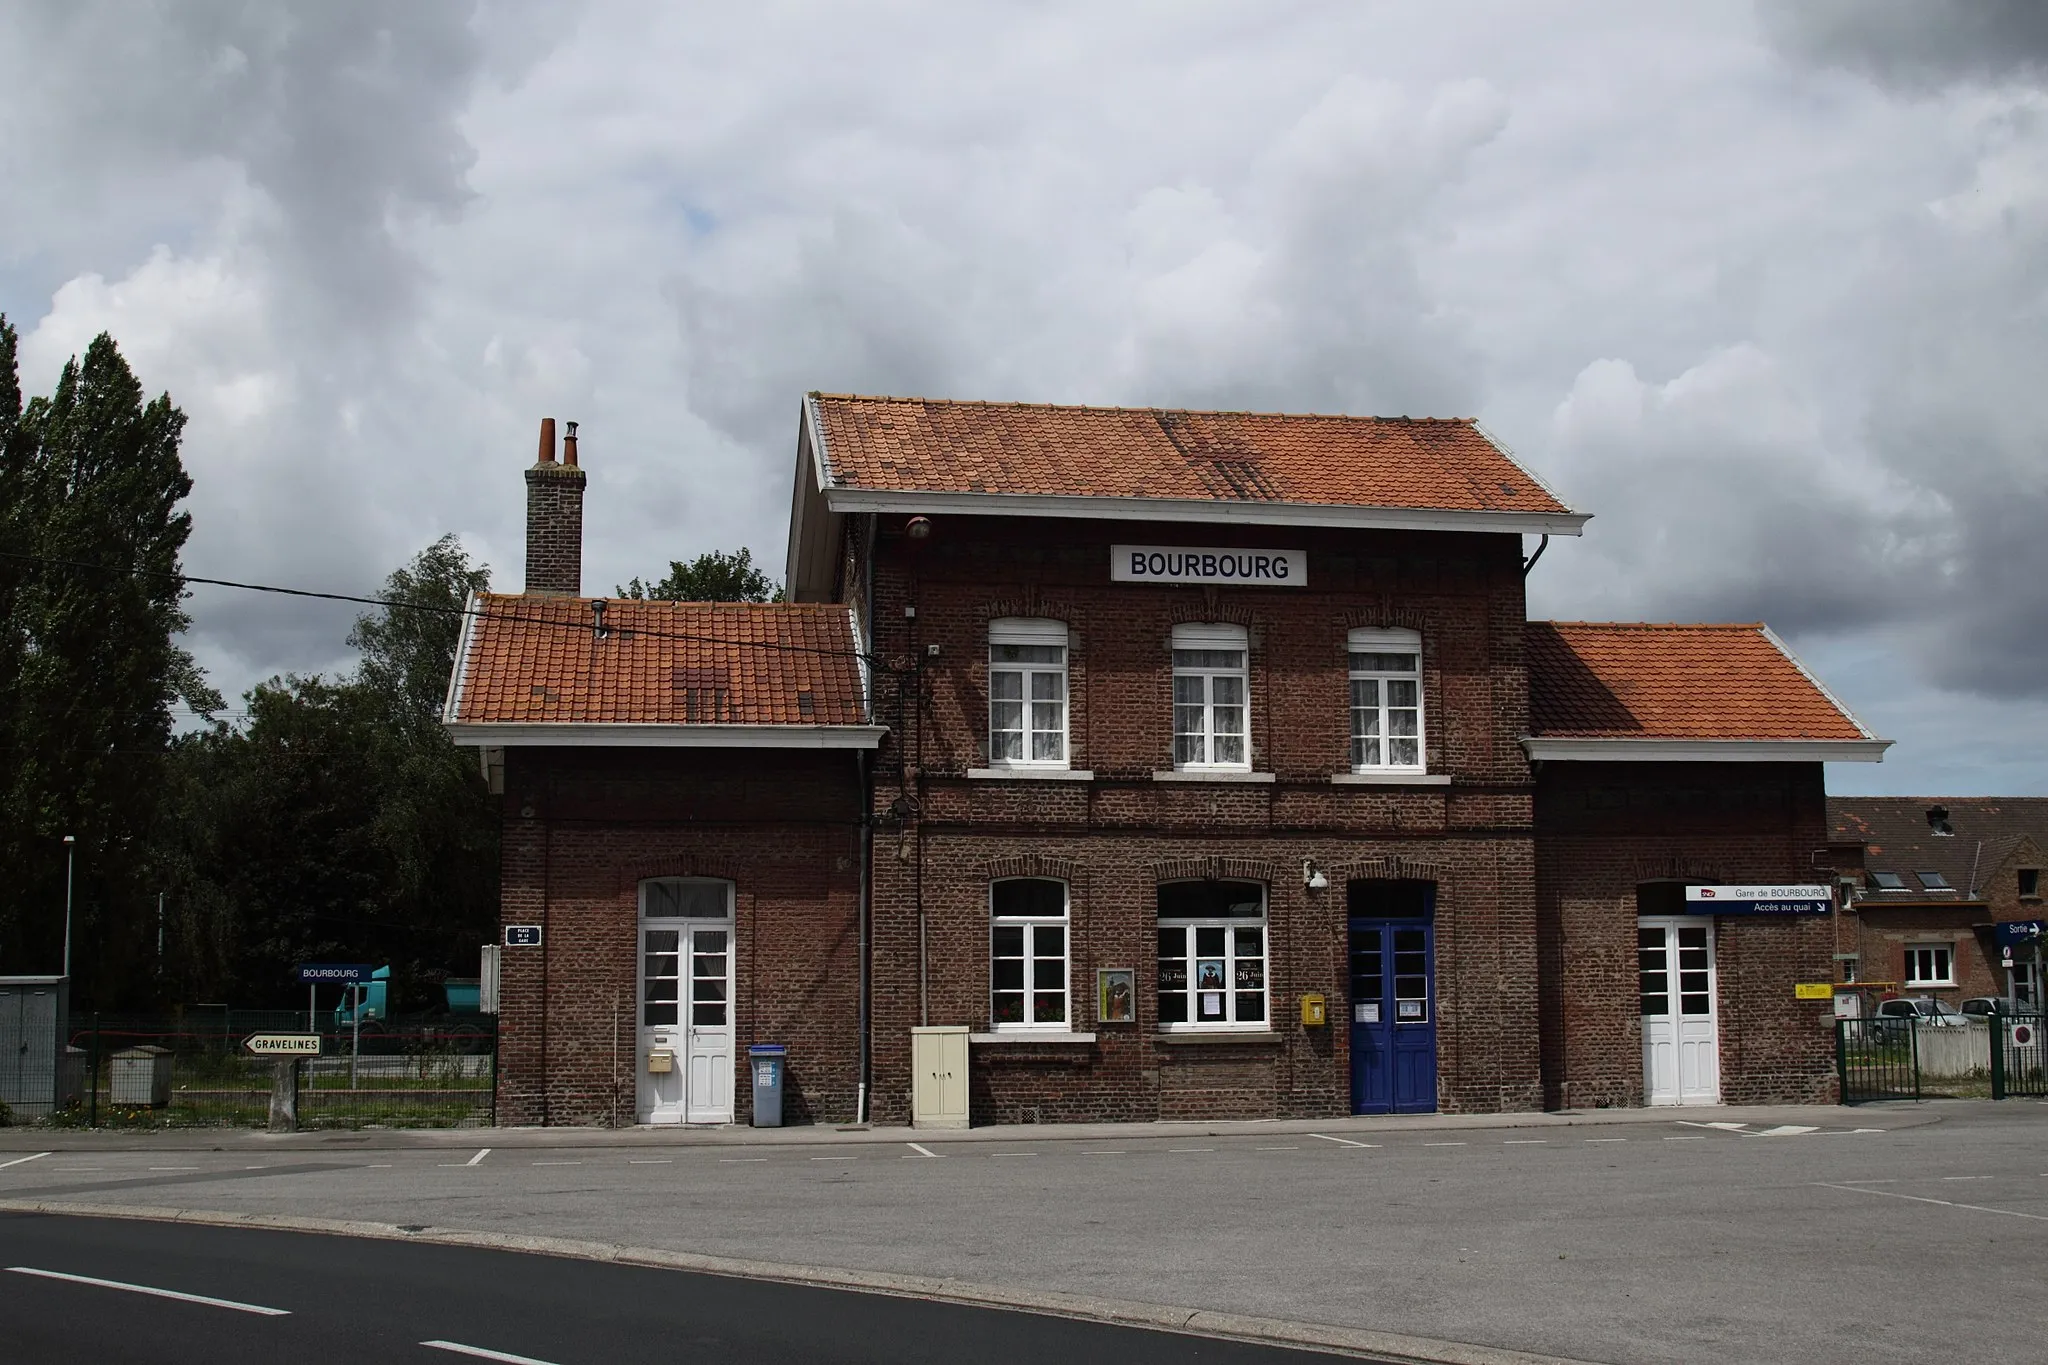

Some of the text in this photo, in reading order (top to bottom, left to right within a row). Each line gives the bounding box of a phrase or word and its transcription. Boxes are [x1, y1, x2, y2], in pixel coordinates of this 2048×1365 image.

[1131, 552, 1289, 579] BOURBOURG
[1735, 888, 1825, 898] Gare de BOURBOURG
[1754, 902, 1778, 912] Accès
[1793, 903, 1811, 914] quai
[2009, 923, 2028, 934] Sortie
[303, 969, 359, 978] BOURBOURG
[1159, 972, 1172, 982] 26
[1236, 970, 1249, 981] 26
[255, 1039, 318, 1050] GRAVELINES
